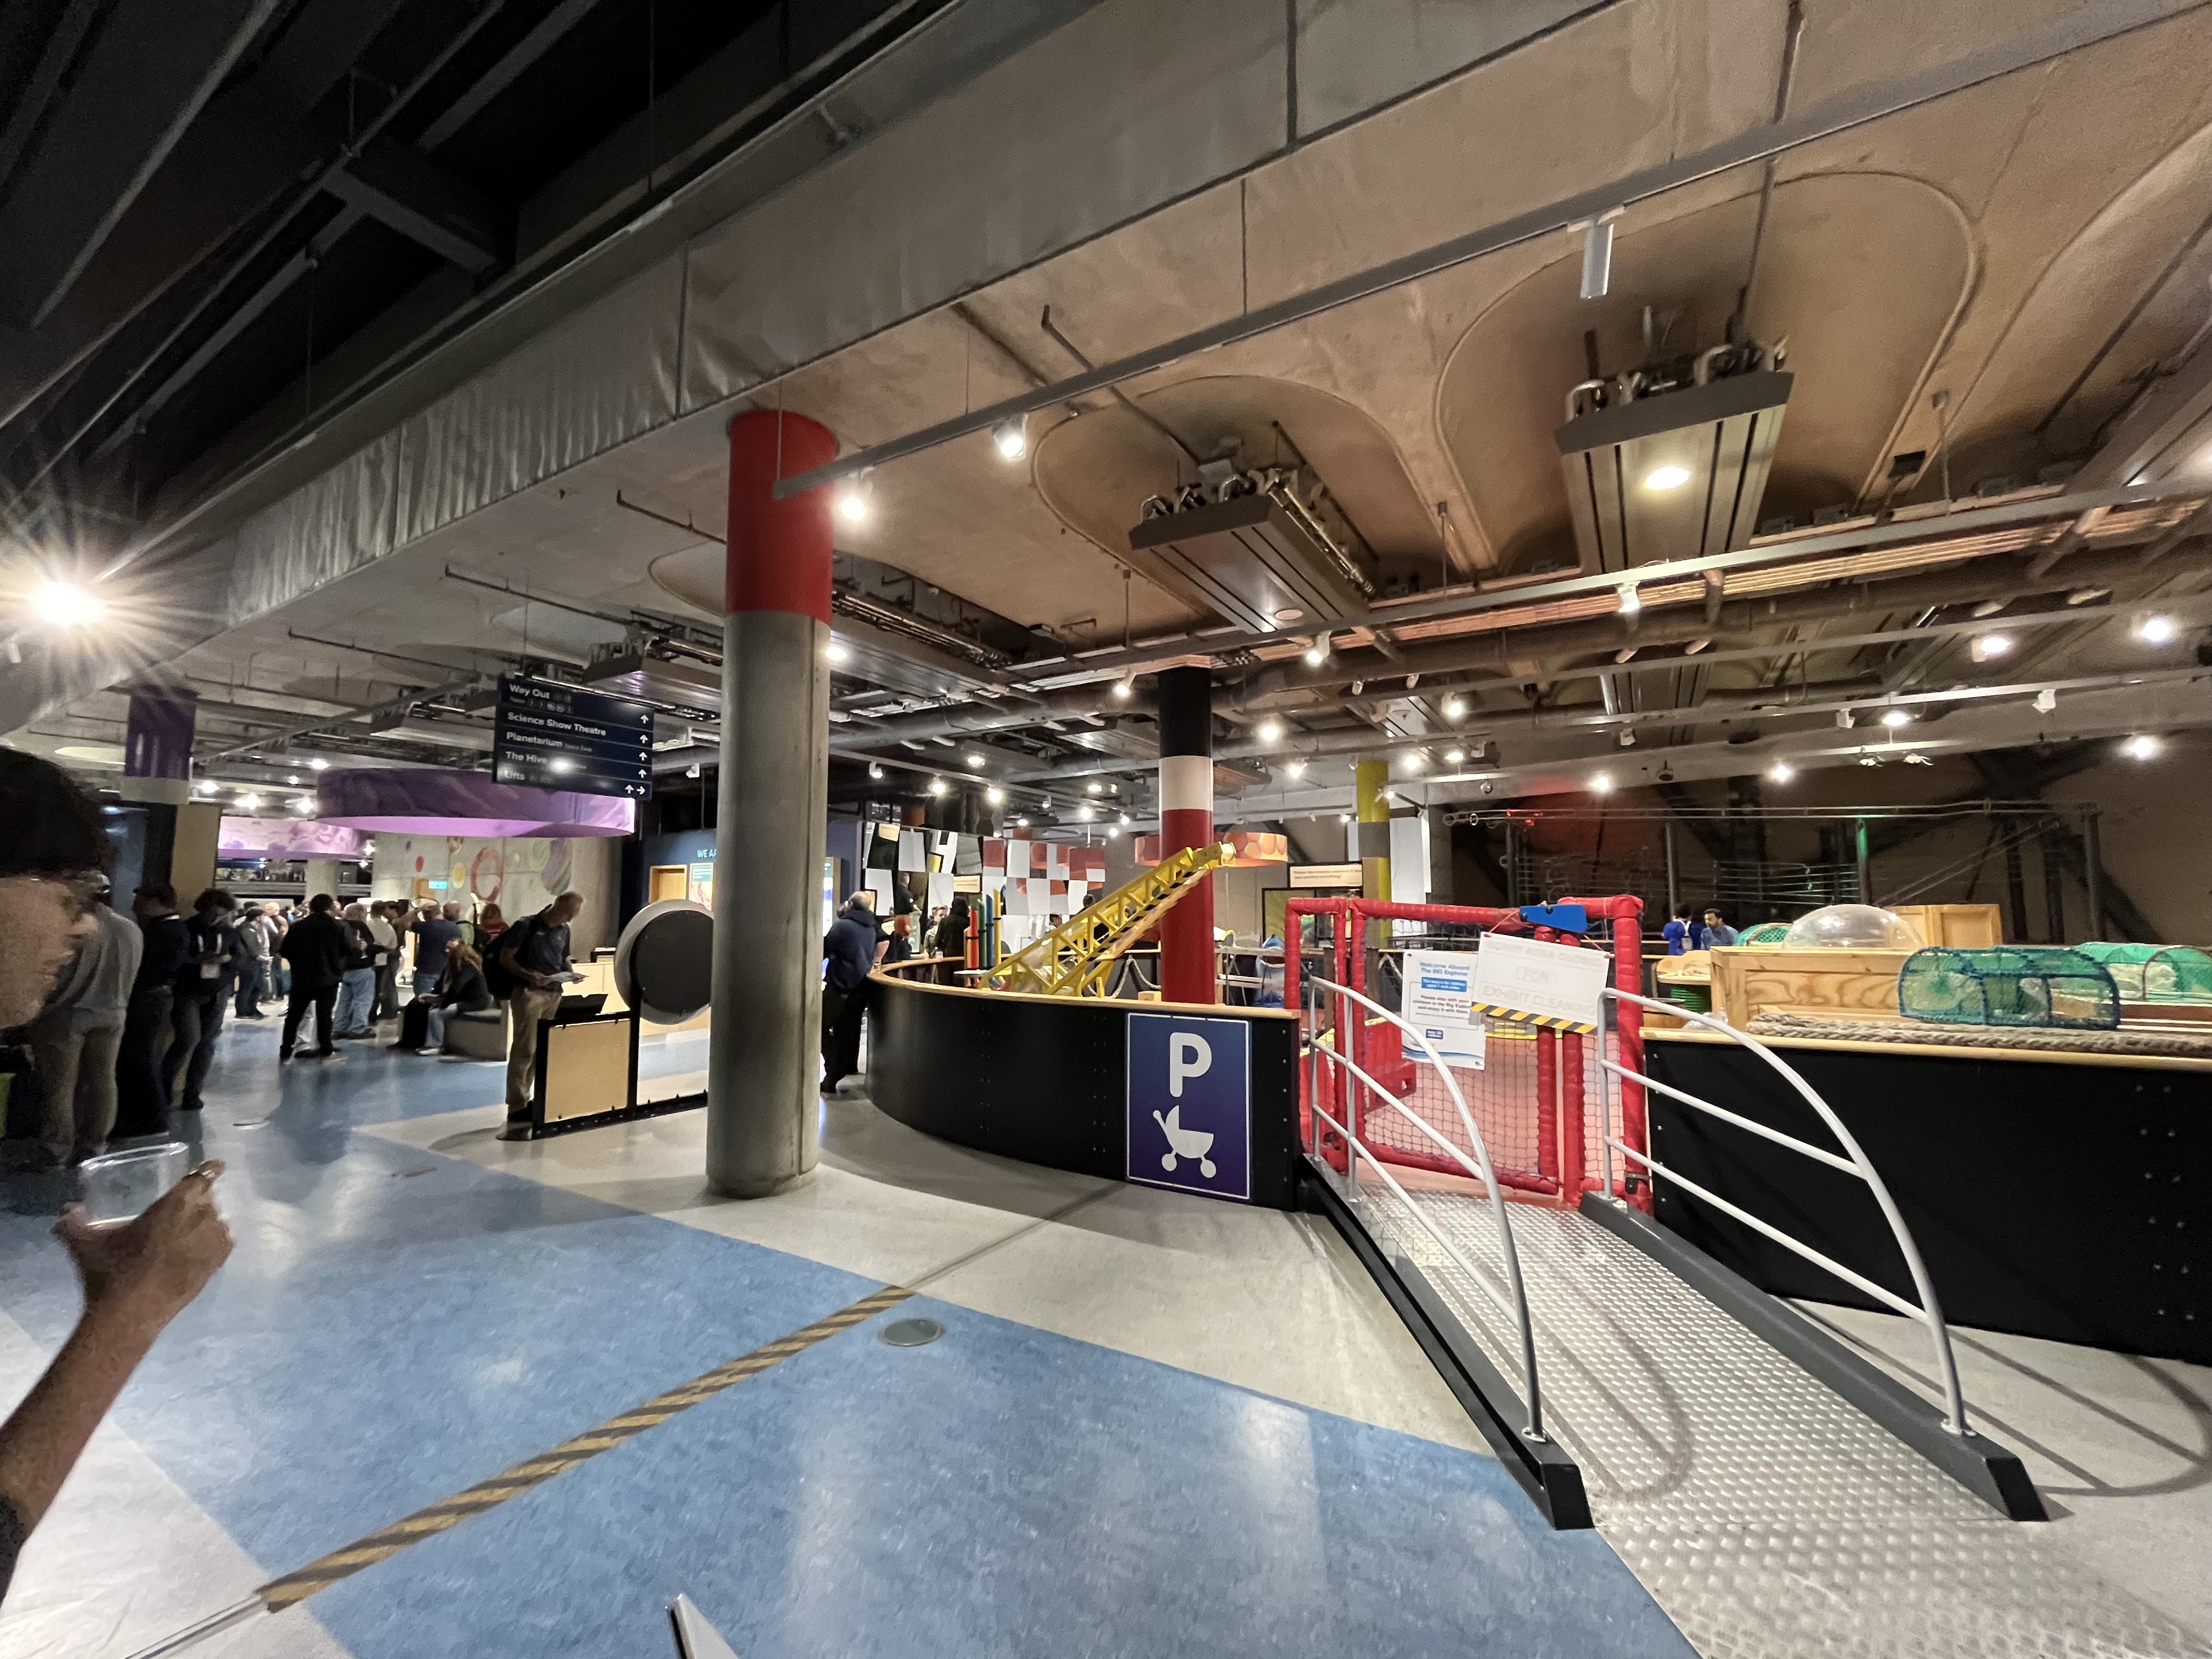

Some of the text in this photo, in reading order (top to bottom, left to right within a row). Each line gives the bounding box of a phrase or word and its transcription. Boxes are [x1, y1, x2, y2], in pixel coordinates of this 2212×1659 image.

[509, 684, 550, 699] Way Out
[508, 712, 606, 736] Science Show Theatre
[507, 732, 563, 748] Planetarium
[505, 752, 547, 764] The Hive
[504, 770, 525, 780] Lifts
[697, 849, 708, 858] WE
[1523, 970, 1550, 983] FOR
[1483, 986, 1596, 1016] EXHIBIT CLEANING
[1170, 1032, 1212, 1097] P
